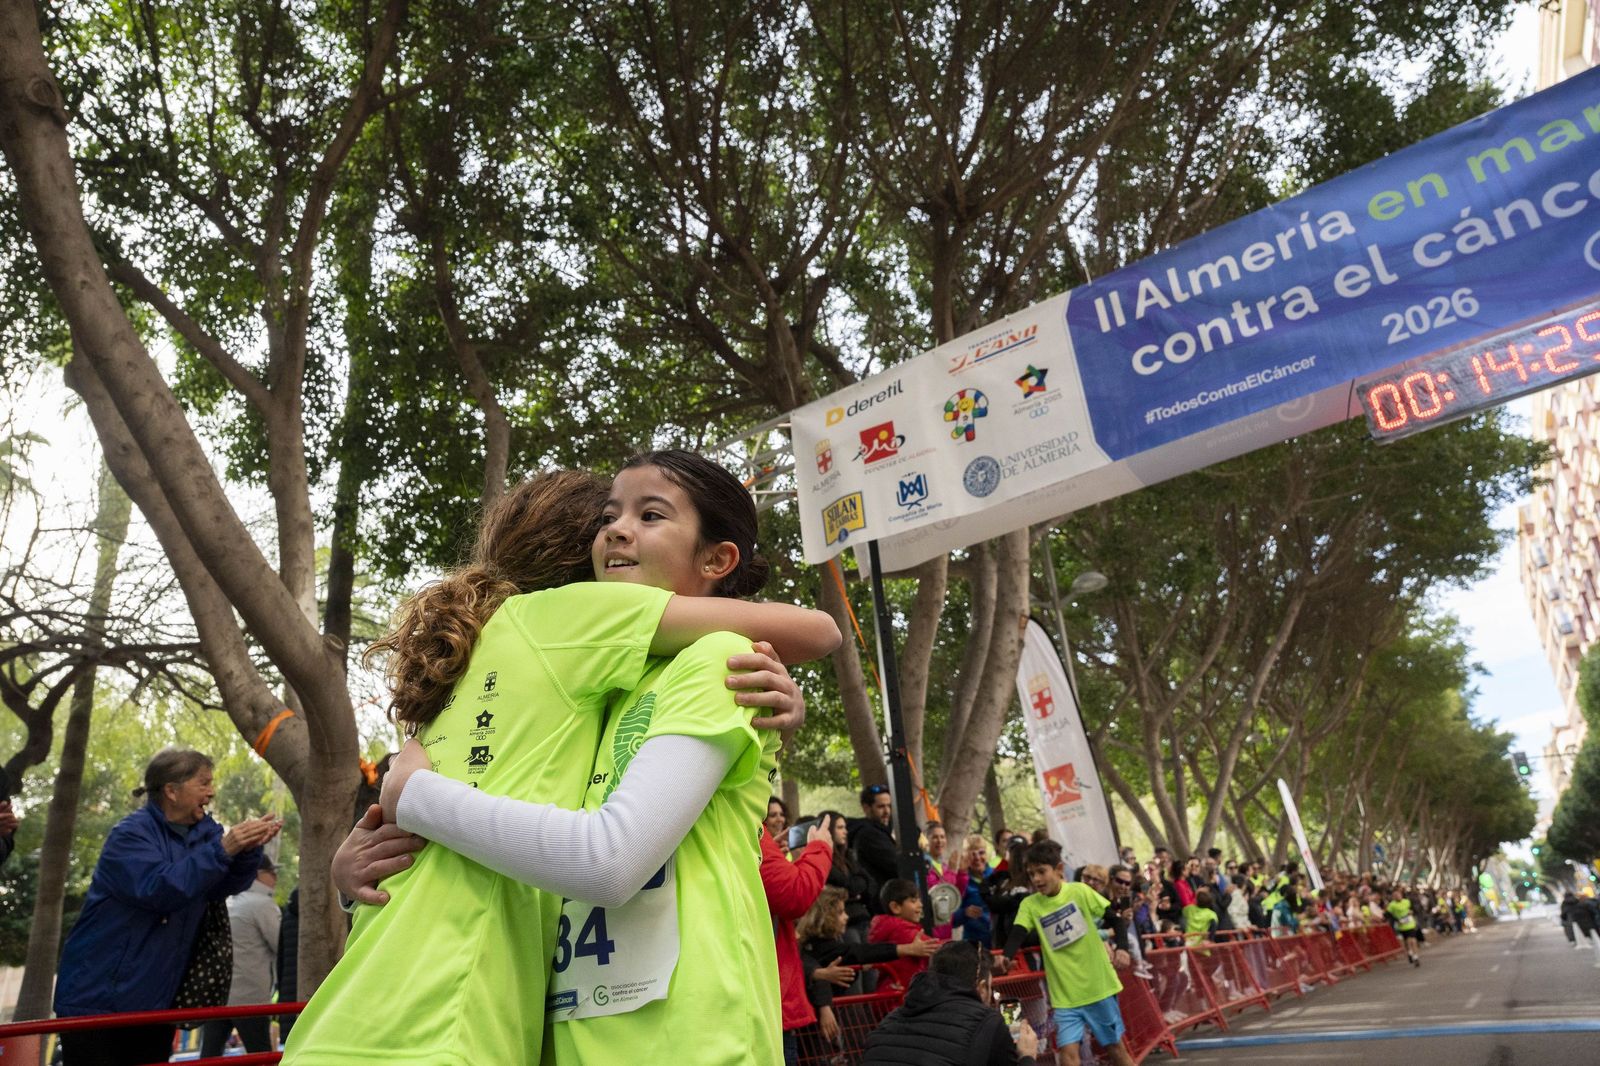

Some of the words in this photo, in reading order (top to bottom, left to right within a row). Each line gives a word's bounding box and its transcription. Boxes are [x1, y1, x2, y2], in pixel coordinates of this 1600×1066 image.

[1093, 290, 1128, 333] II
[1135, 209, 1355, 320] Almería
[1367, 172, 1450, 221] en
[1131, 281, 1319, 376] contra
[1333, 243, 1399, 299] el
[1381, 287, 1480, 346] 2026
[846, 379, 904, 417] deretil
[1144, 355, 1317, 425] #TodosContraElCáncer
[999, 431, 1079, 468] UNIVERSIDAD
[1001, 465, 1020, 480] DE
[1023, 443, 1082, 473] ALMERÍA
[1054, 919, 1074, 936] 44
